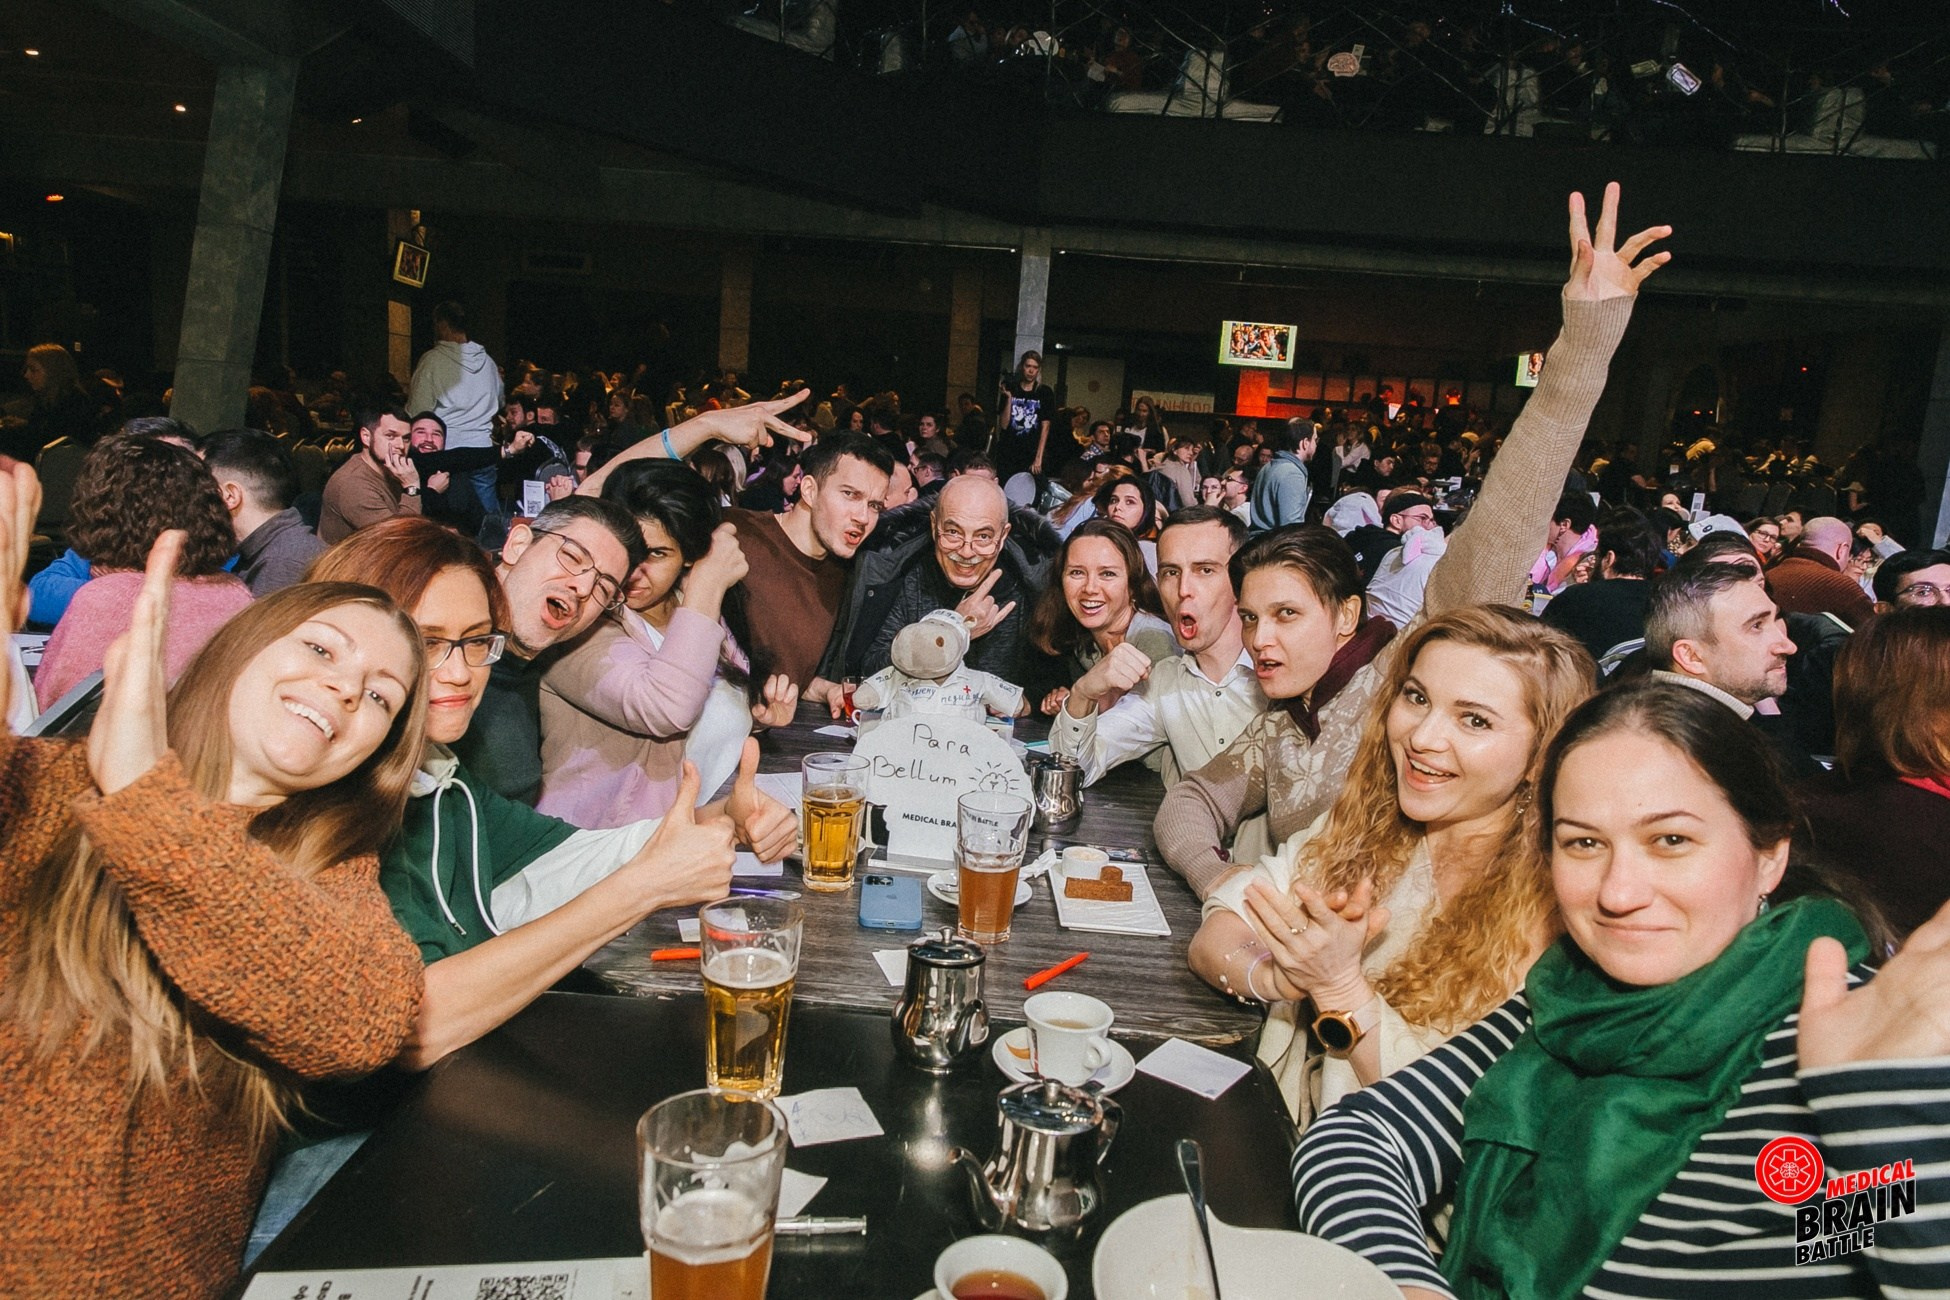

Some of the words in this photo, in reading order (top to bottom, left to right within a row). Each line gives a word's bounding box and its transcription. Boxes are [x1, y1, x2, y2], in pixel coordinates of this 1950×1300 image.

[912, 723, 971, 757] Para
[873, 755, 957, 786] Bellum
[902, 812, 939, 826] MEDICAL
